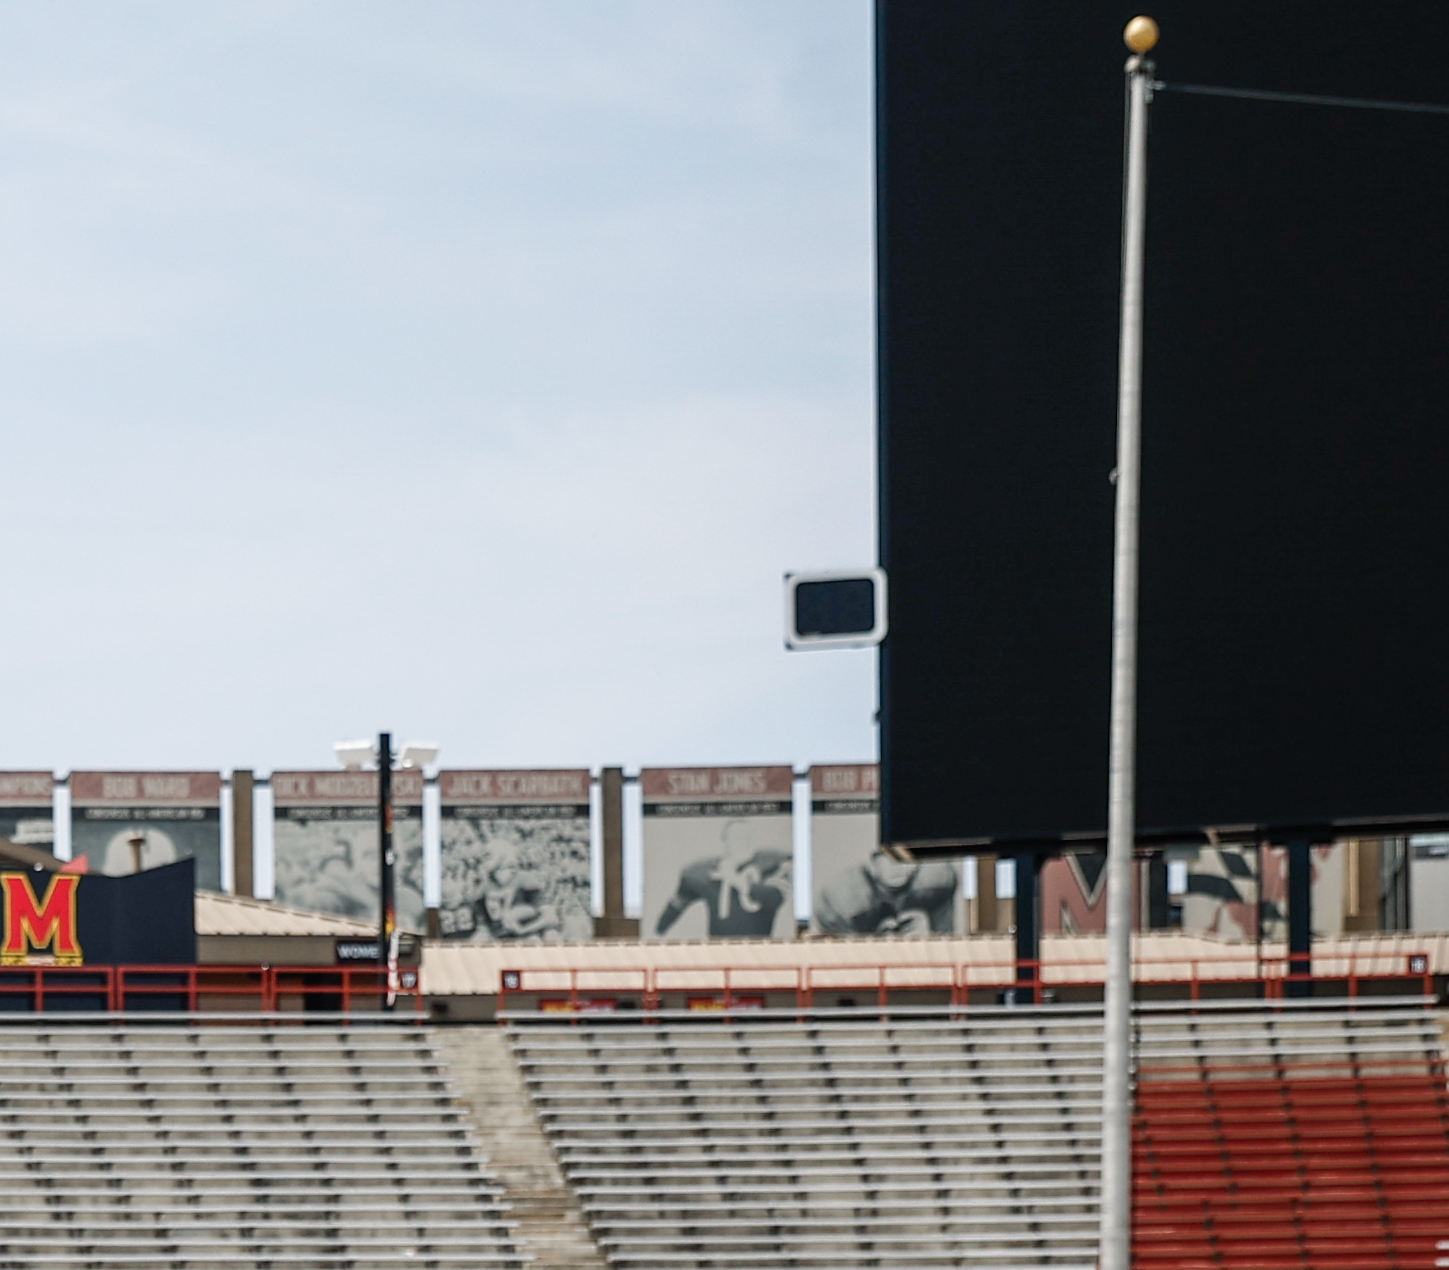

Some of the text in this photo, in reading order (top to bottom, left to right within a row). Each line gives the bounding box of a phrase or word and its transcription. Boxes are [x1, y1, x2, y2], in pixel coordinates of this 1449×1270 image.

[314, 774, 421, 798] MODZELESKI
[449, 774, 491, 797] JACK
[667, 770, 767, 795] STAN JONES
[337, 941, 381, 959] WOME
